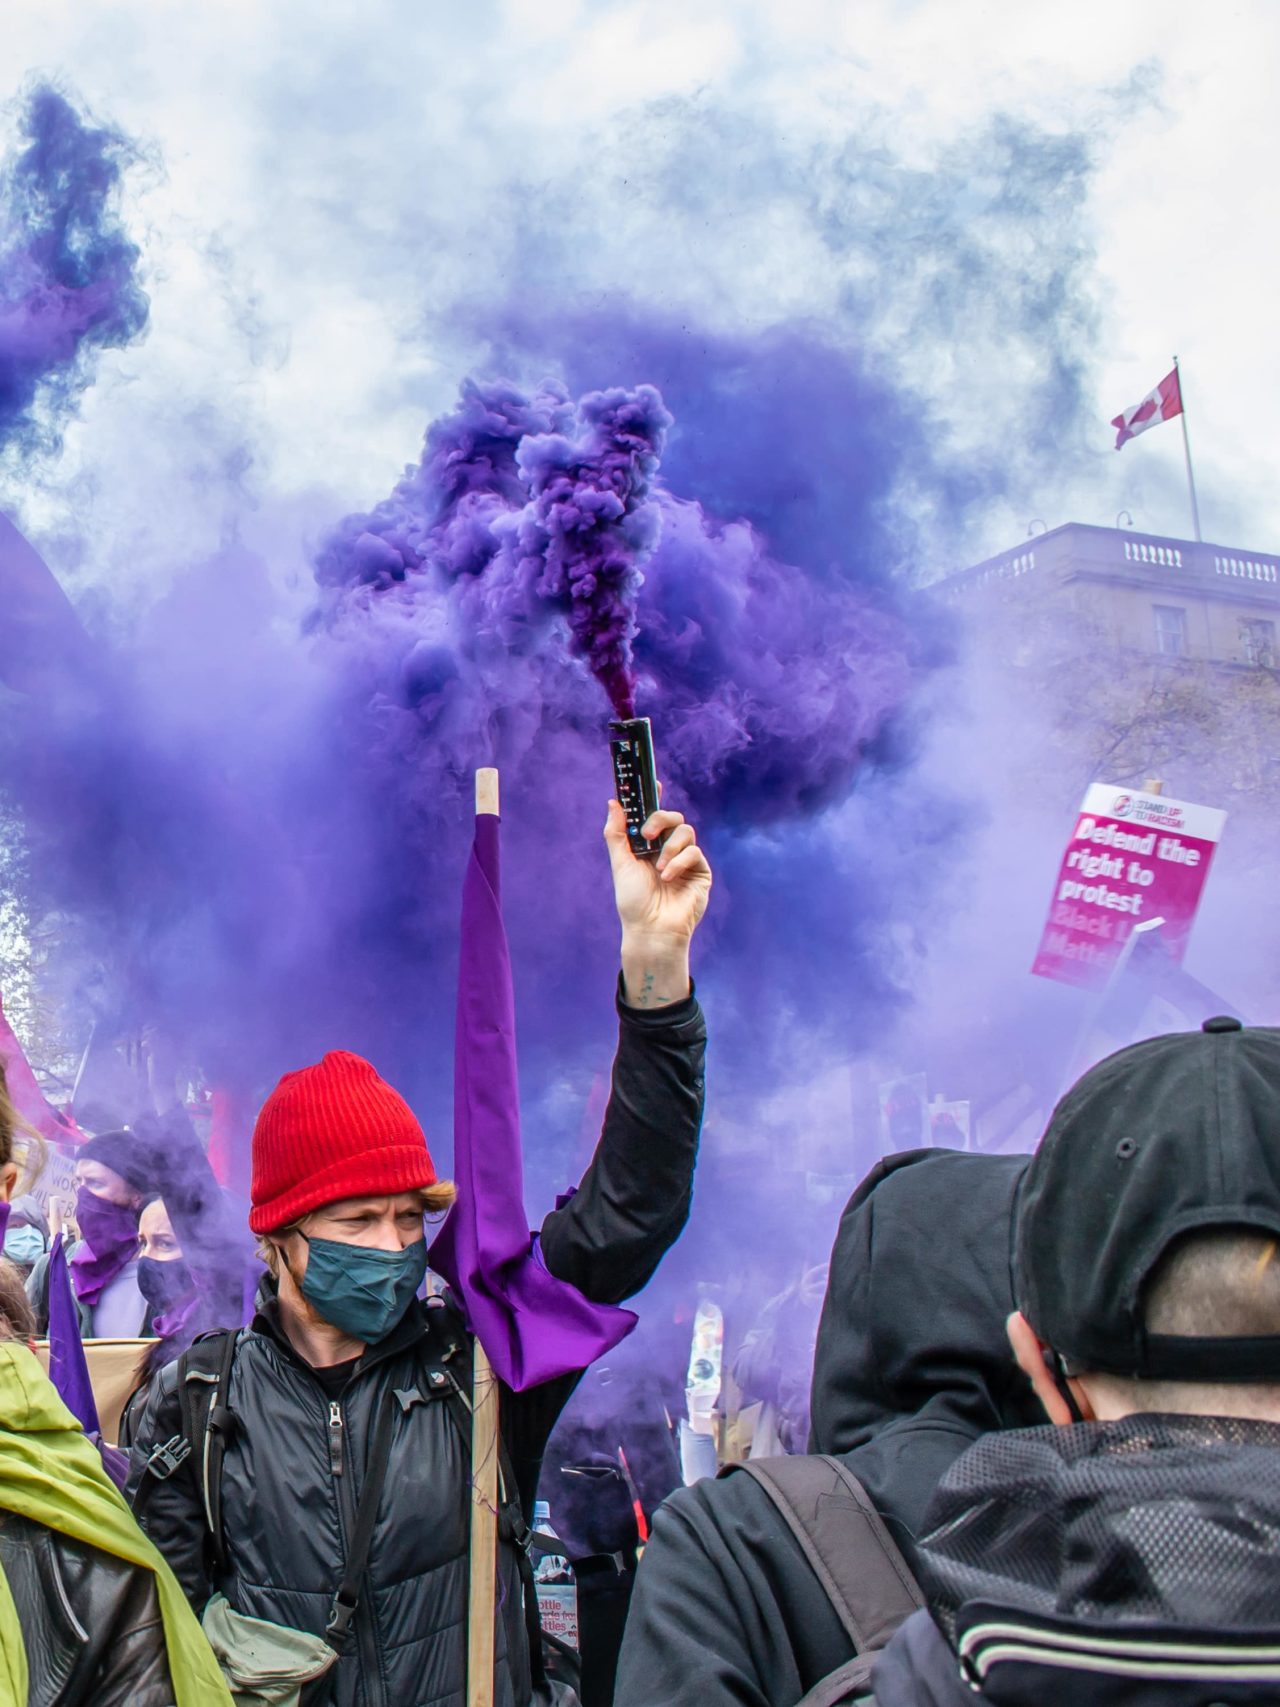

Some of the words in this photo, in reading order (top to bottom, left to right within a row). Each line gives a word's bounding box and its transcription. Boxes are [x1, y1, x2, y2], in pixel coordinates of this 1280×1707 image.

[1075, 817, 1157, 856] Defend
[1157, 837, 1201, 867] the
[1066, 847, 1125, 880] right
[1126, 861, 1155, 887] to
[1058, 879, 1144, 915] protest
